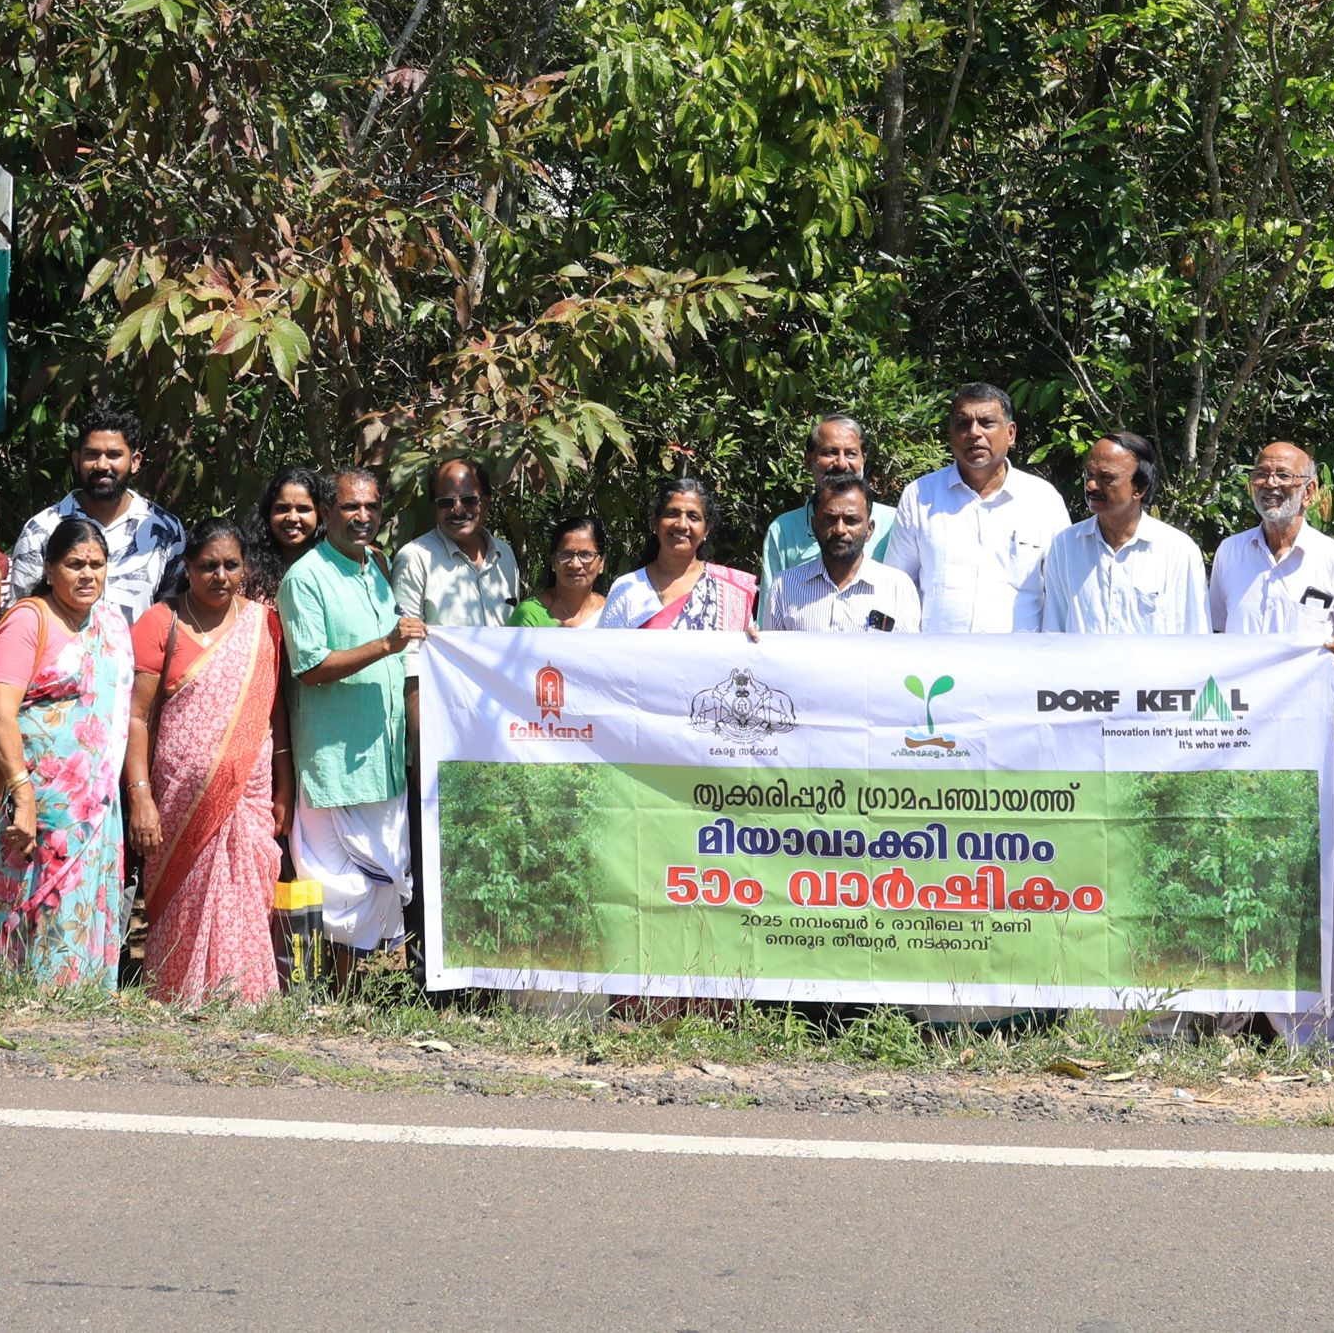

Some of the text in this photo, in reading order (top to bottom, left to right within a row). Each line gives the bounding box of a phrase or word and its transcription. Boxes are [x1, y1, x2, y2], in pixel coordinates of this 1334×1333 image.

[1037, 675, 1249, 722] DORF KETAL
[1101, 727, 1150, 736] Innovation
[1152, 727, 1173, 736] isn't
[1175, 727, 1193, 738] just
[1195, 727, 1218, 736] what
[1236, 727, 1251, 736] do.
[709, 746, 779, 758] കേരള സർക്കാർ
[1179, 741, 1193, 749] It's
[1195, 741, 1215, 749] who
[693, 778, 1081, 816] തൃക്കരിപ്പൂർ ഗ്രാമപഞ്ചായത്ത്
[697, 818, 1055, 863] മിയാവാക്കി വനം
[666, 865, 1105, 913] 5ാം വാർഷികം
[740, 915, 1032, 933] 2025 നവംബർ 6 രാവിലെ 11 മണി
[765, 933, 992, 953] നെരൂദ തീയറ്റർ, നടക്കാവ്
